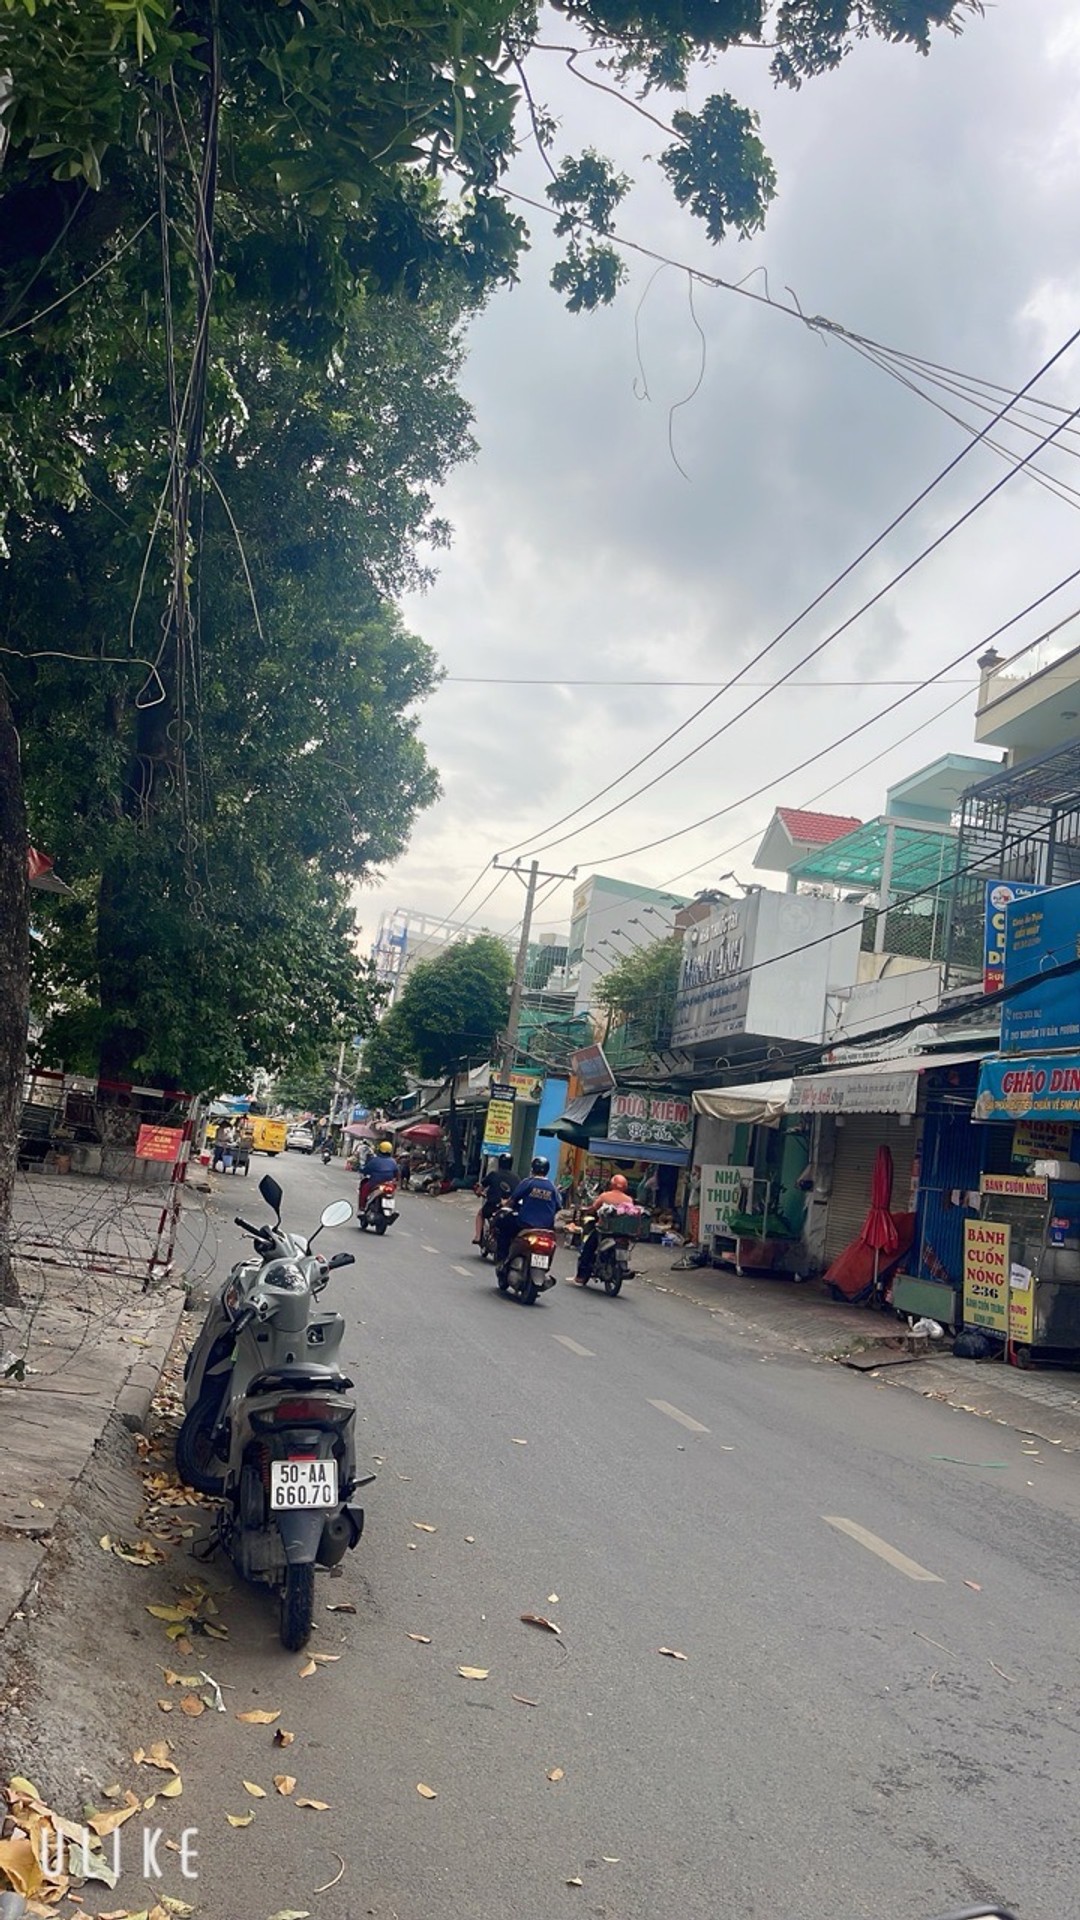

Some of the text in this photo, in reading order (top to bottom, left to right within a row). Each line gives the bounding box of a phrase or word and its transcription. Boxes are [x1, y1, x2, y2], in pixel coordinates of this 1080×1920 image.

[715, 1169, 741, 1184] NHÀ
[707, 1187, 739, 1203] THUỐ
[967, 1227, 1005, 1246] BÁNH
[967, 1247, 1005, 1266] CUỐN
[967, 1267, 1005, 1286] NÓNG
[971, 1285, 999, 1299] 236
[281, 1464, 326, 1483] 50-AA
[276, 1484, 332, 1505] 660.70
